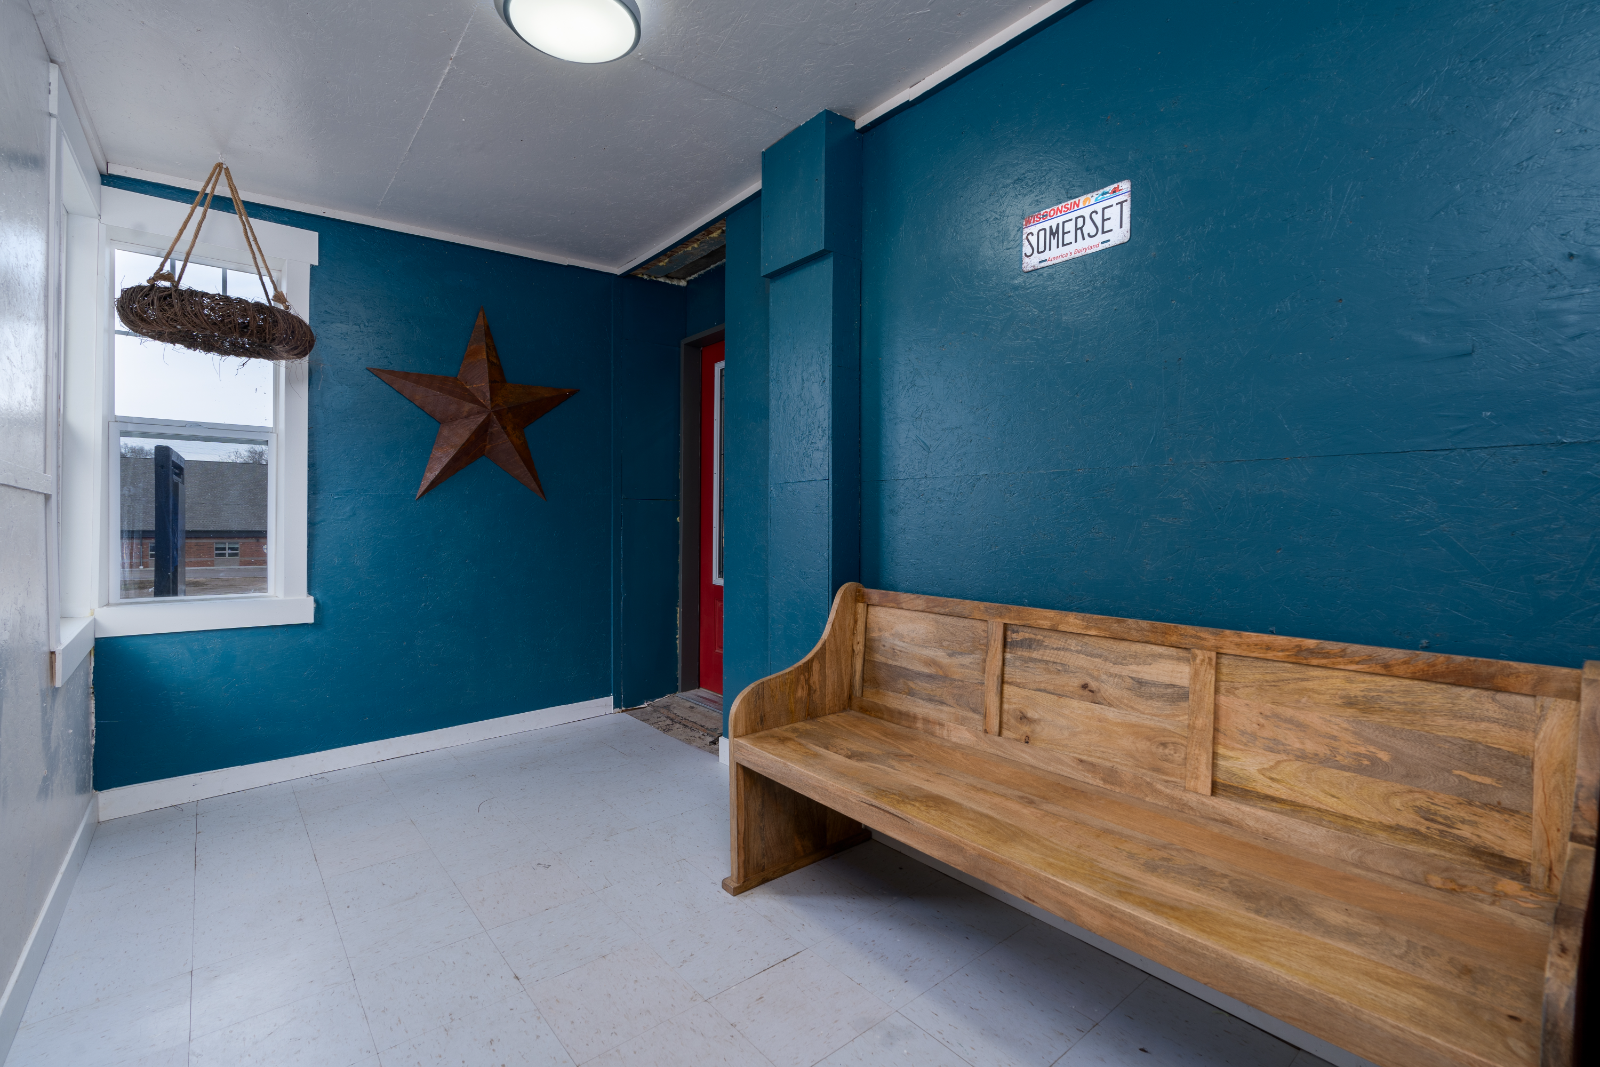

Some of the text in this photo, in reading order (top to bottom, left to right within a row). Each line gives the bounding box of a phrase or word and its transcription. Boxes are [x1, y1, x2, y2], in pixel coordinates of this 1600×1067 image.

[1024, 199, 1081, 227] WISCONSIN
[1024, 199, 1128, 258] SOMERSET
[1047, 242, 1100, 262] America's Dairyland
